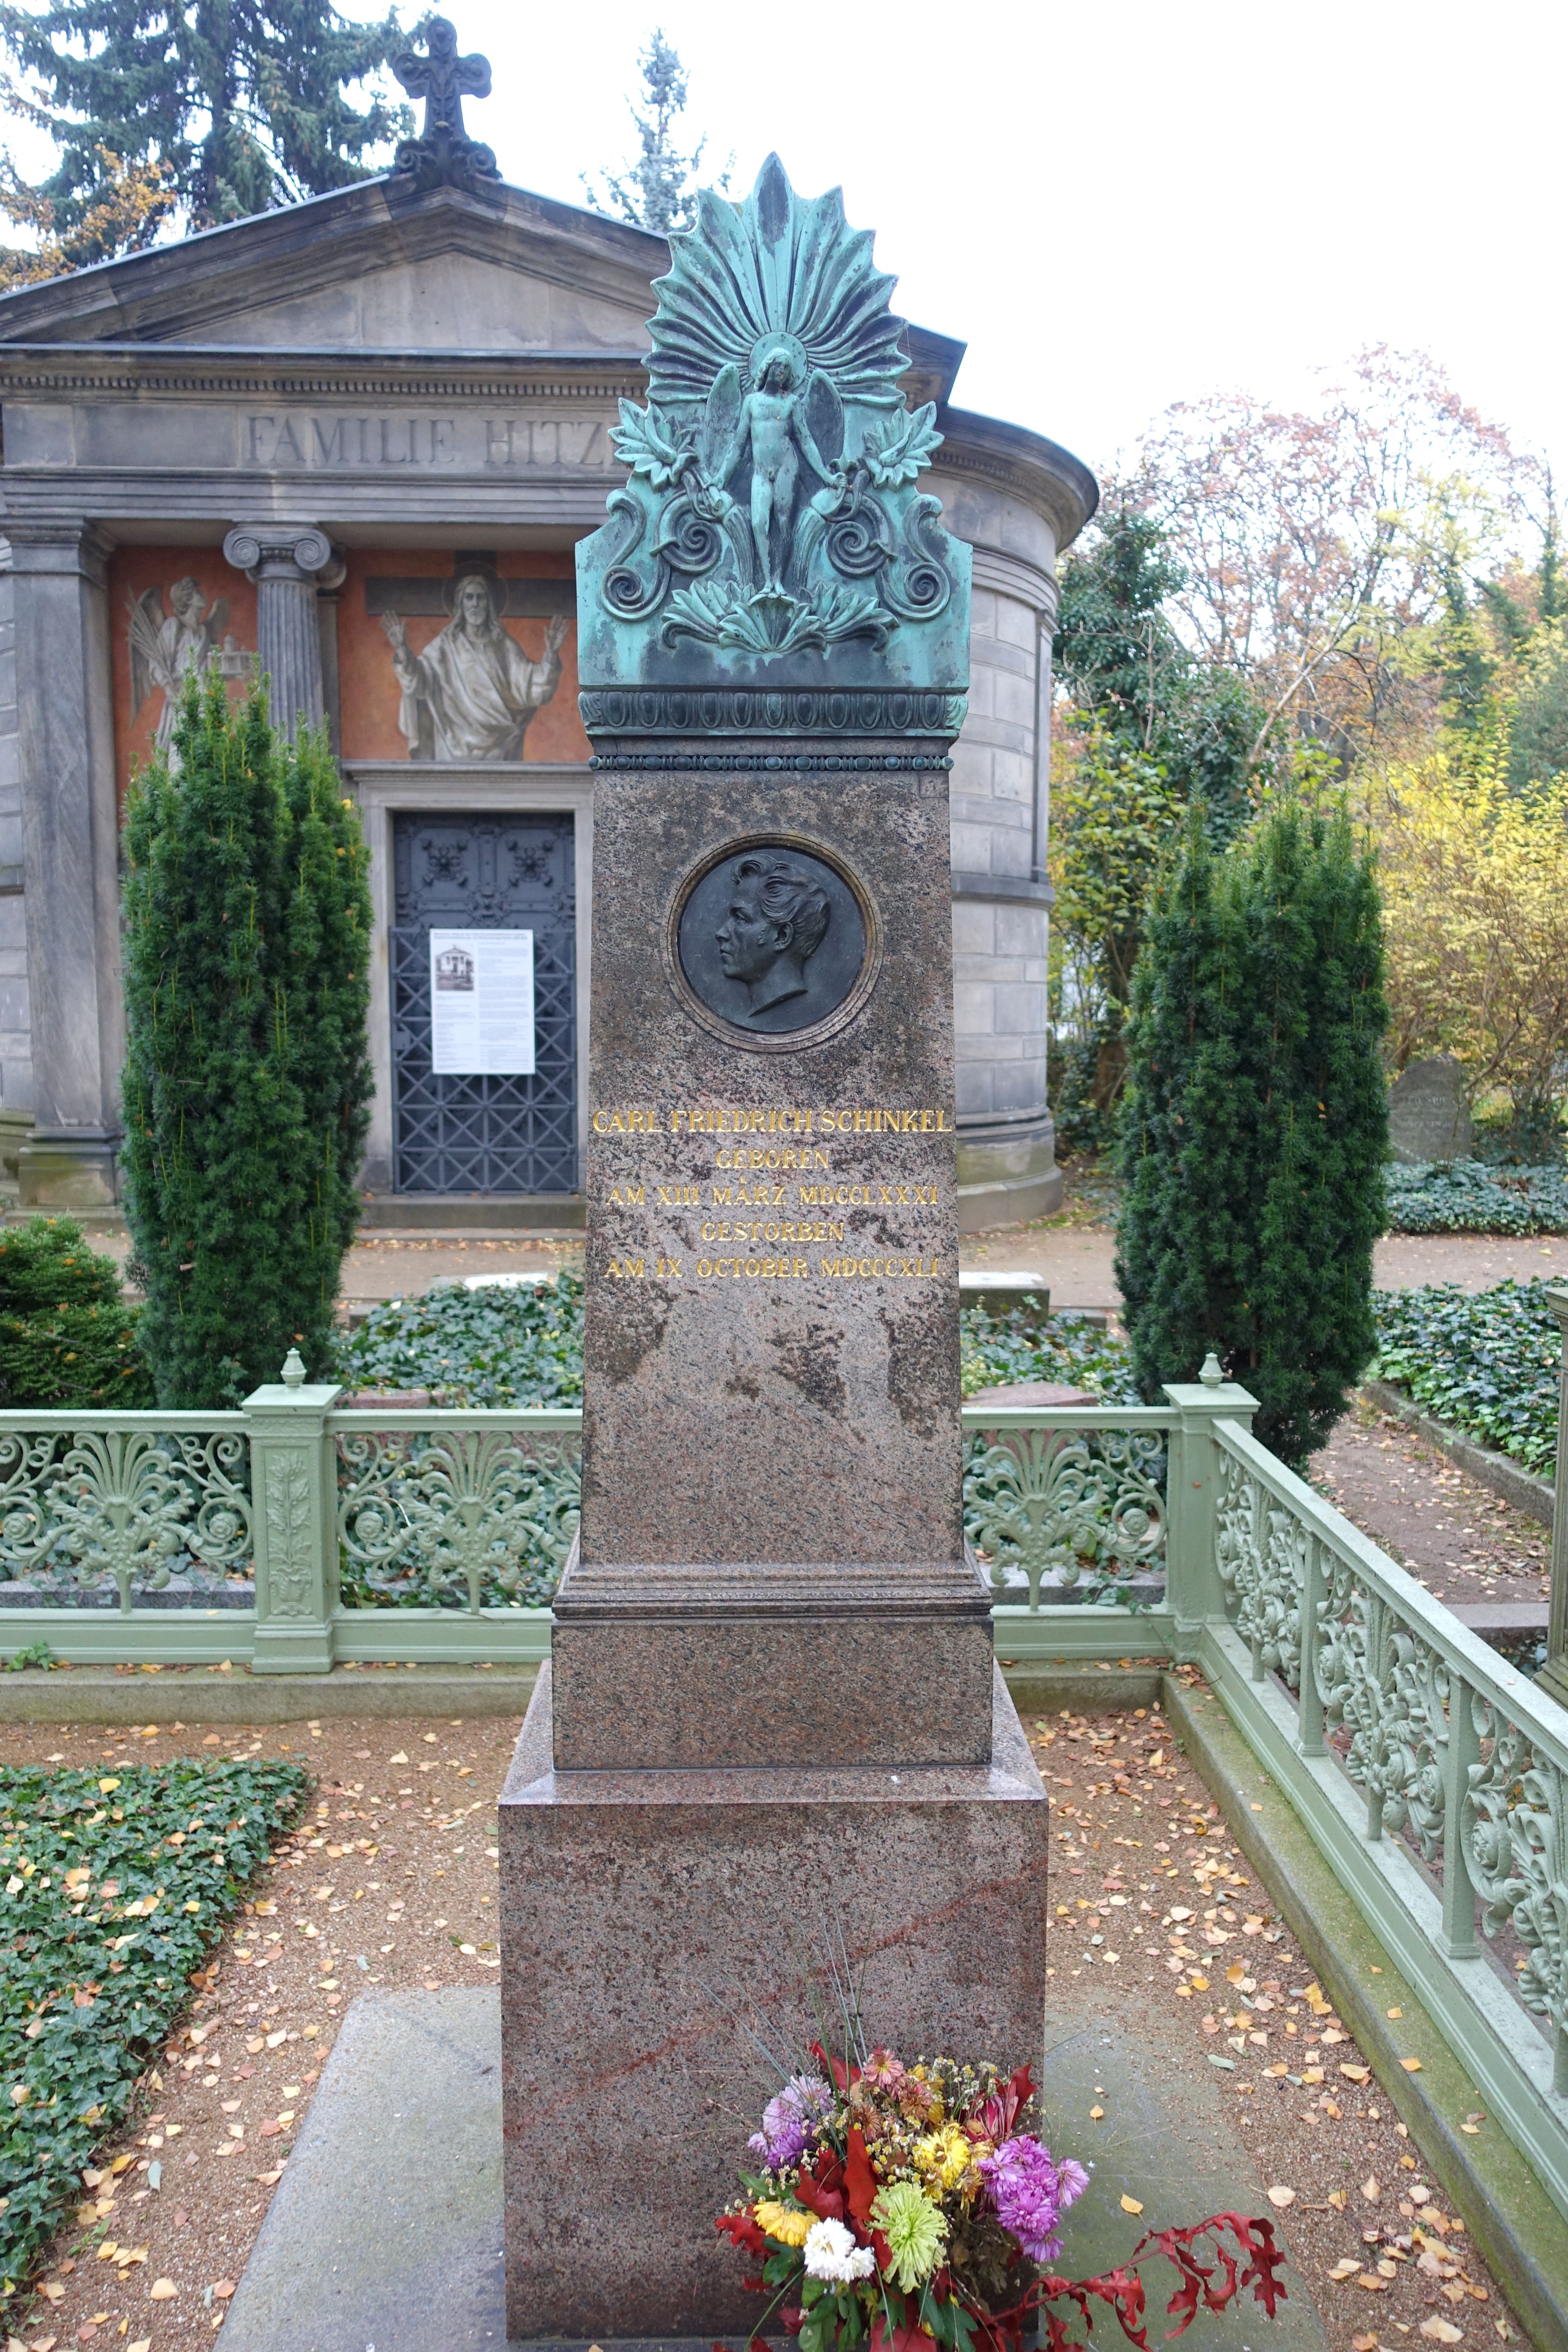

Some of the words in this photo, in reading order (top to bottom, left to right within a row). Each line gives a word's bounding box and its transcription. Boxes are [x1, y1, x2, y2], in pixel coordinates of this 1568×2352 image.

[248, 416, 455, 462] FAMILIE
[593, 1110, 663, 1133] CARL
[671, 1110, 813, 1133] FRIEDRICH
[820, 1110, 952, 1133] SCHINKEL
[715, 1149, 830, 1169] GEBOREN
[606, 1185, 645, 1205] AM
[656, 1185, 700, 1205] XIII
[799, 1185, 938, 1205] MDCCLXXXI
[701, 1222, 844, 1243] GESTORBEN
[604, 1258, 644, 1278] AM
[656, 1258, 683, 1278] IX
[696, 1258, 808, 1278] OCTOBER
[821, 1257, 946, 1278] MDCCCXLI.
